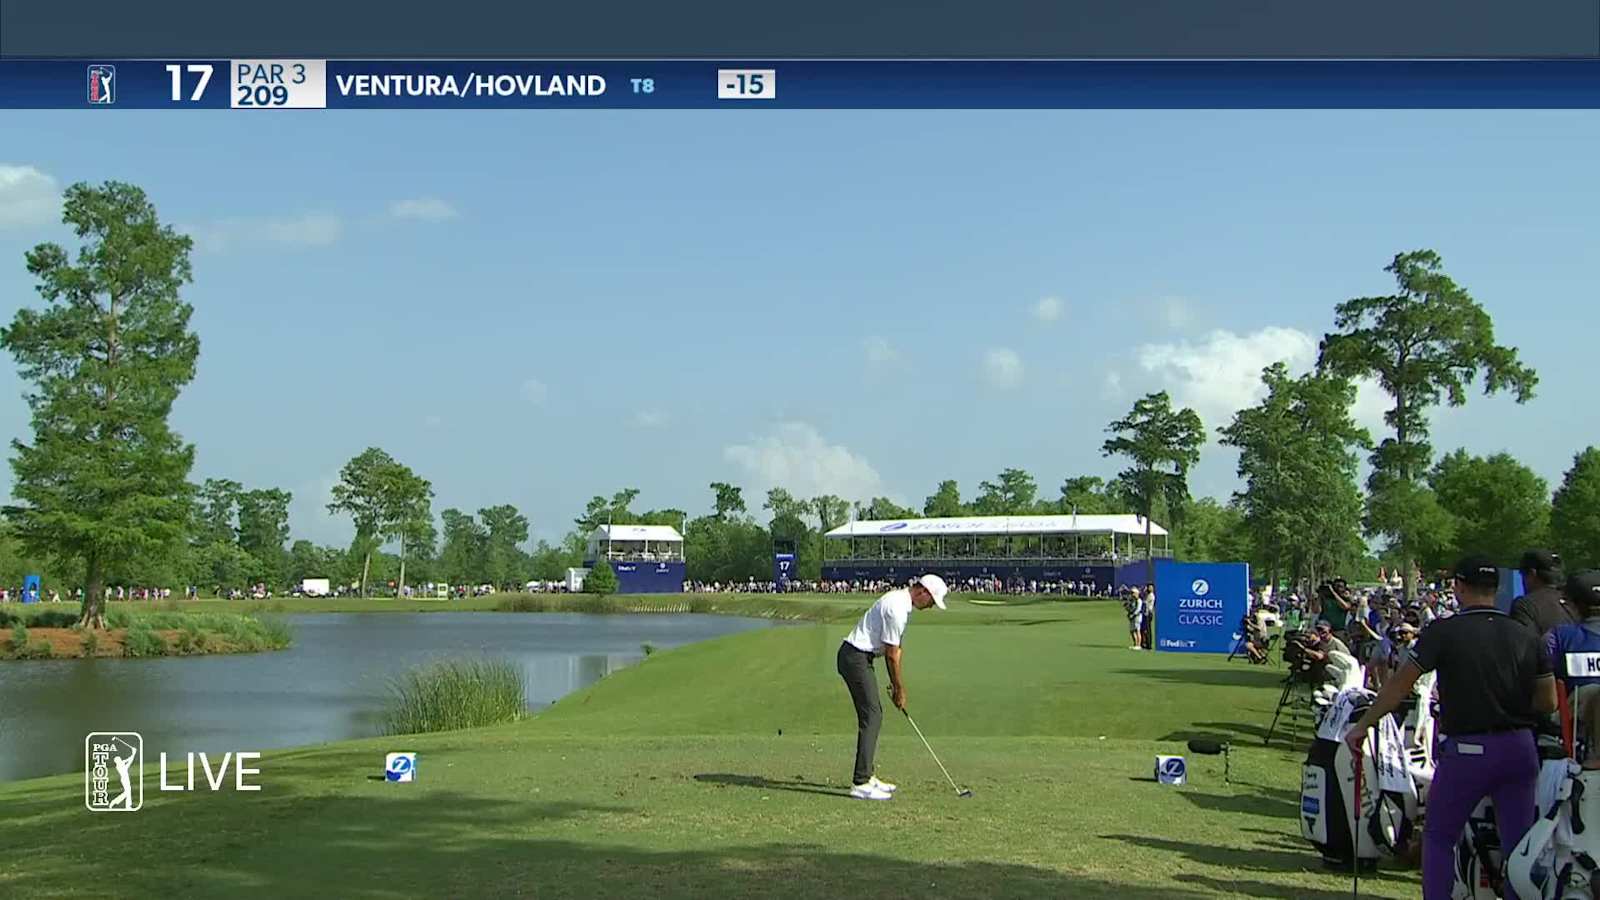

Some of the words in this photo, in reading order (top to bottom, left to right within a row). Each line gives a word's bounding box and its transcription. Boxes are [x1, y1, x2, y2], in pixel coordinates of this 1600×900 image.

[779, 561, 790, 570] 17
[1179, 599, 1223, 609] ZURICH
[1179, 614, 1223, 626] CLASSIC
